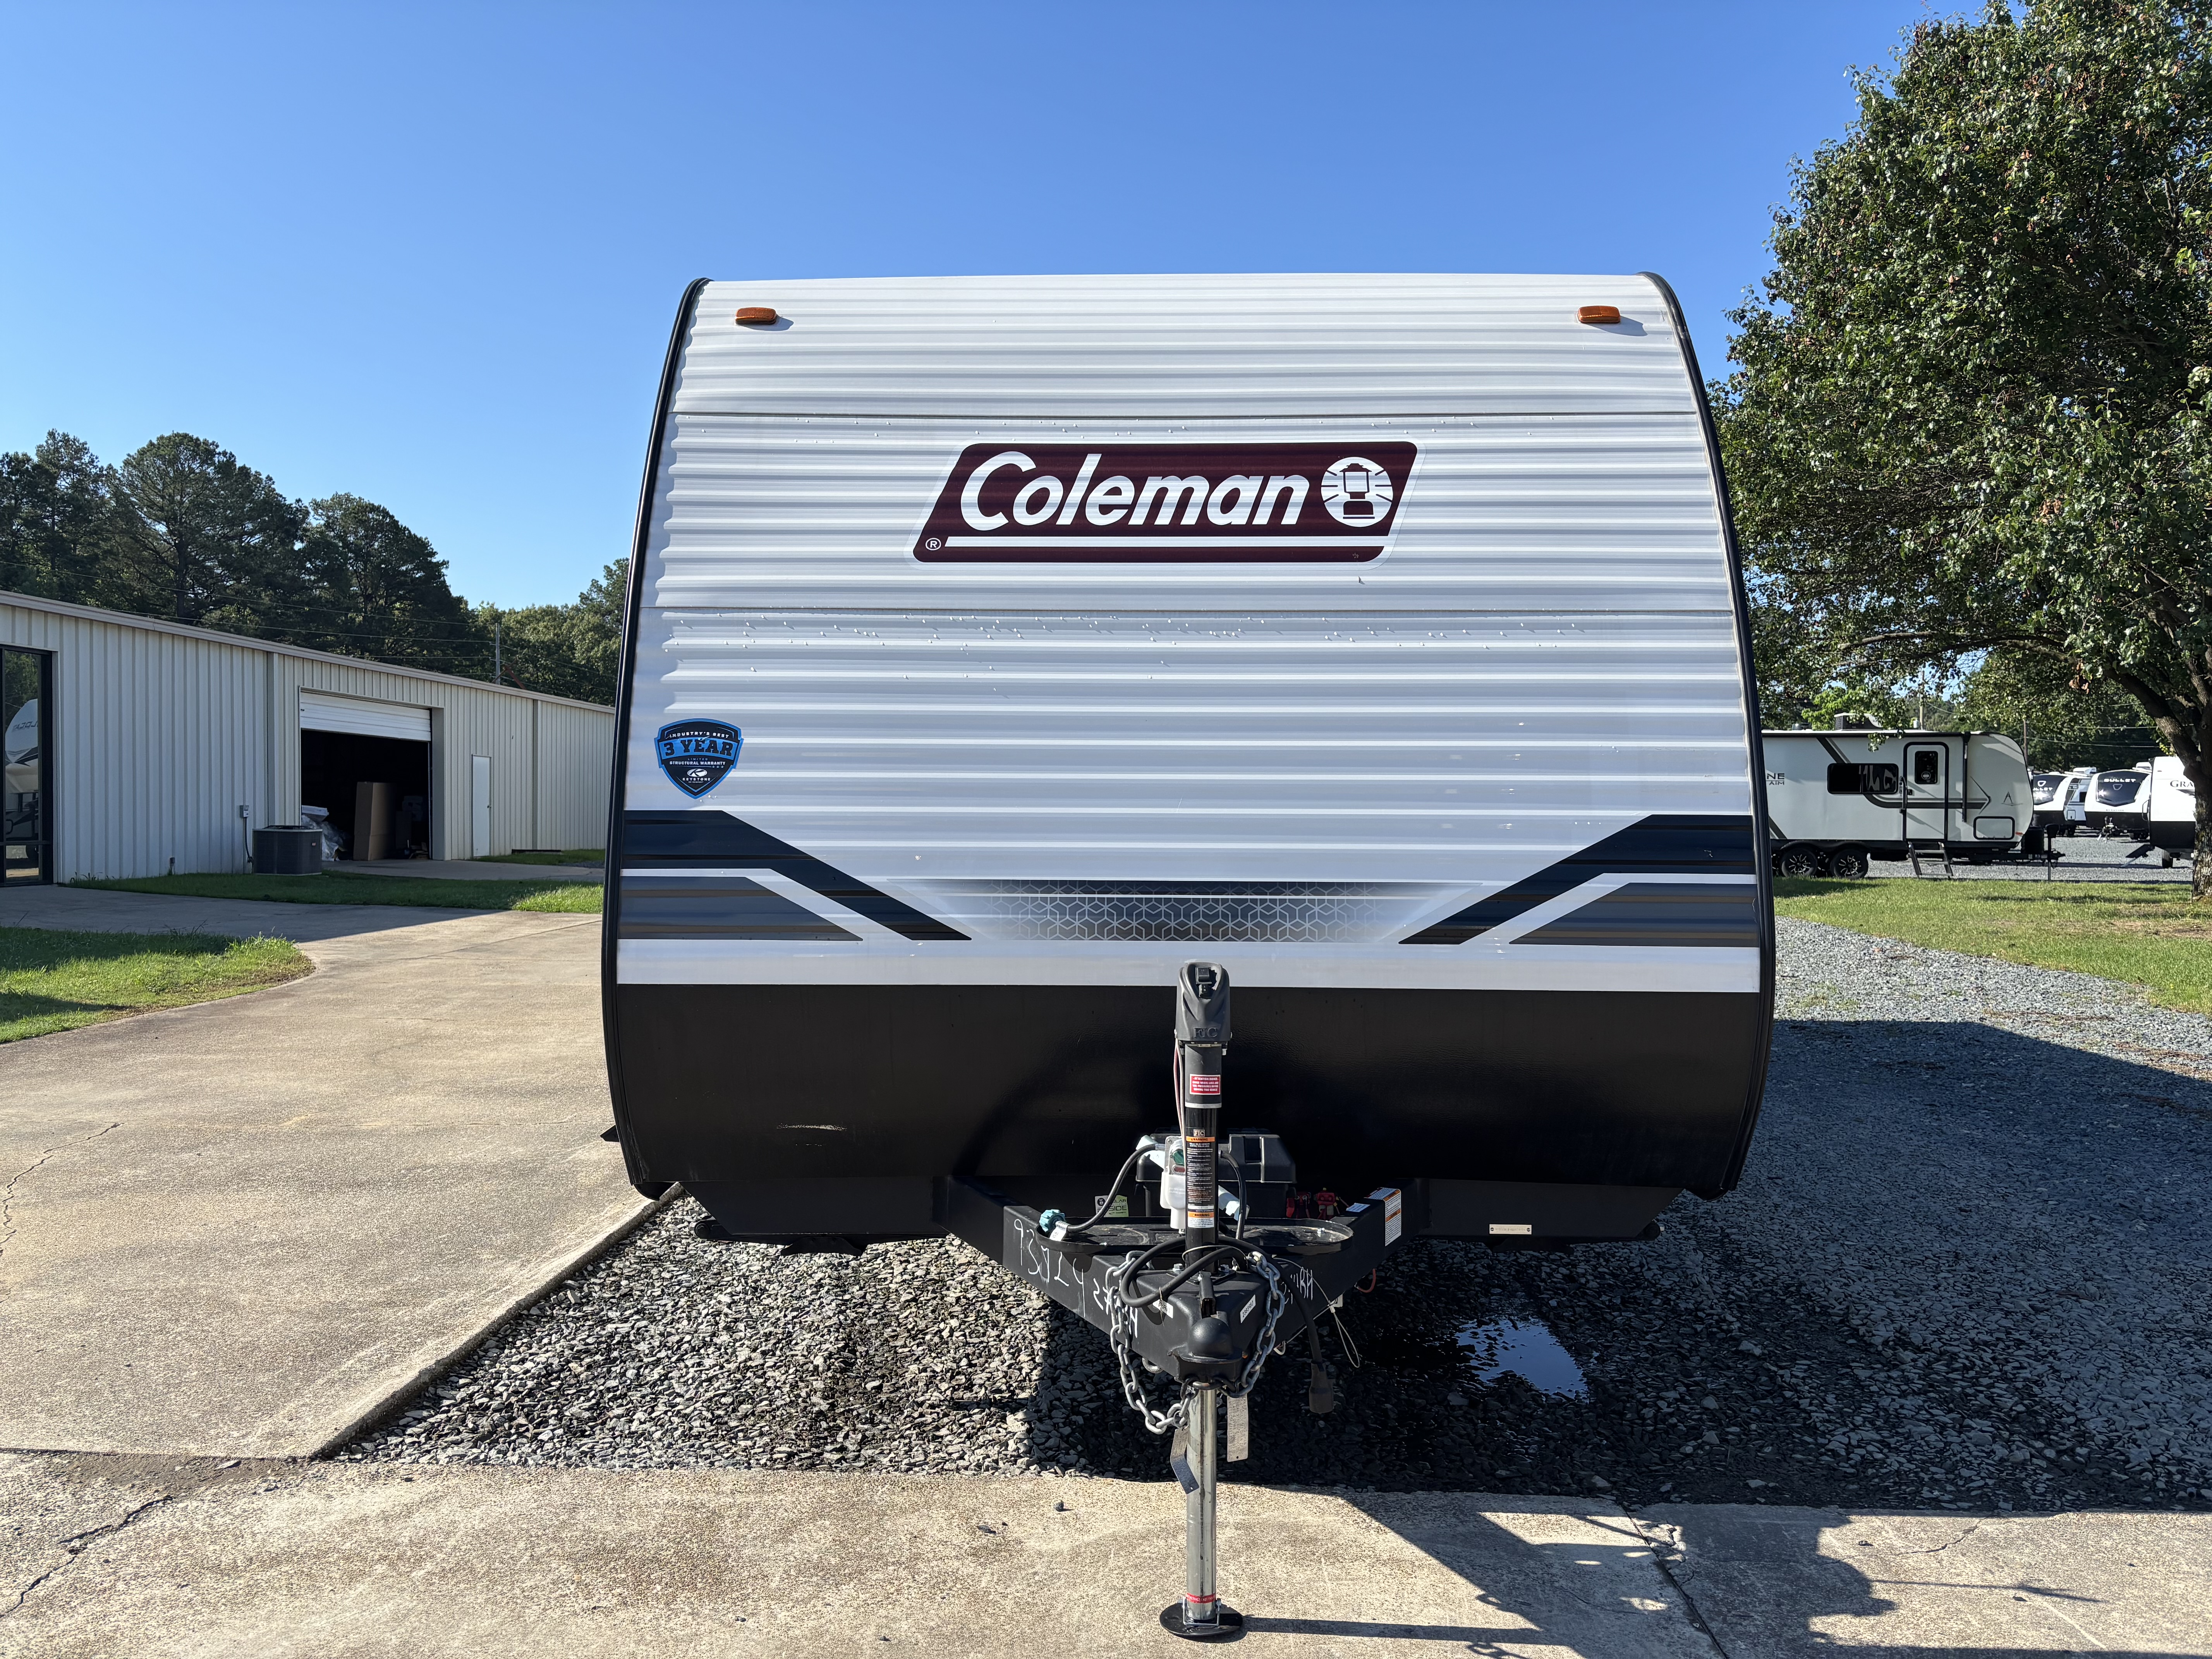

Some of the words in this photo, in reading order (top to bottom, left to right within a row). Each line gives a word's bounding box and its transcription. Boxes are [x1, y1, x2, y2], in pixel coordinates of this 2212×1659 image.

[960, 451, 1310, 531] Coleman
[664, 742, 675, 756] 3
[680, 739, 733, 756] YEAR
